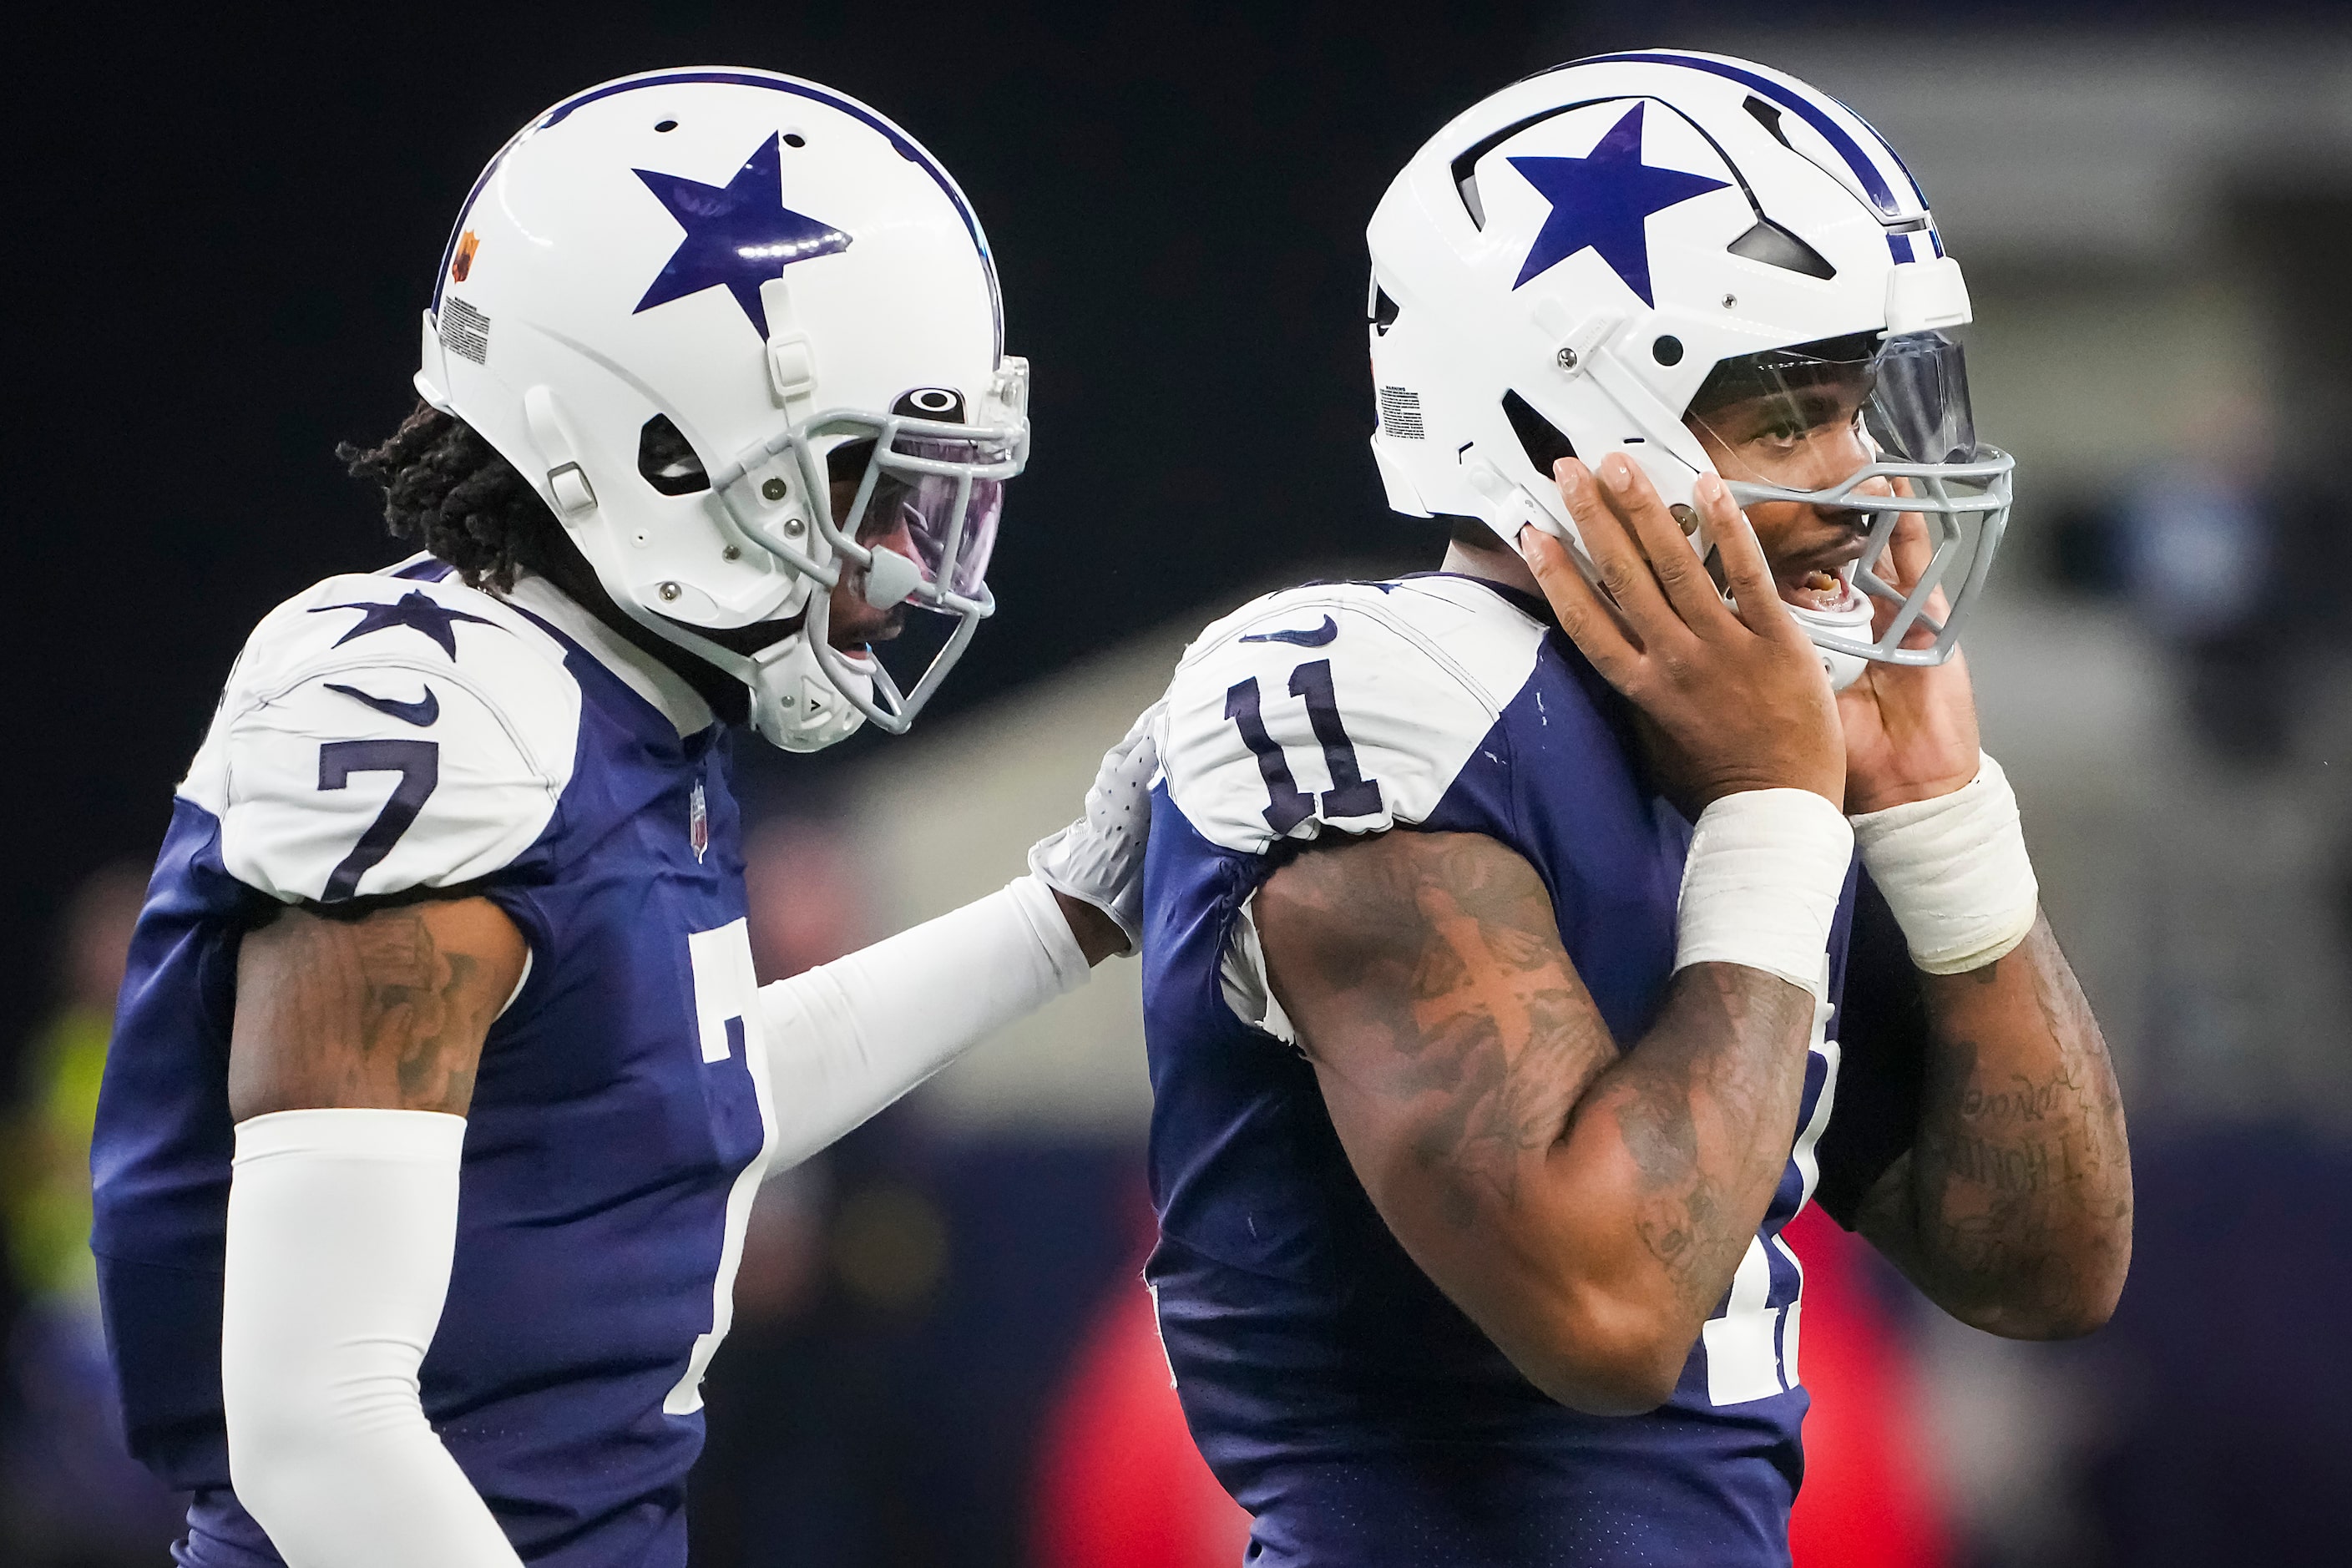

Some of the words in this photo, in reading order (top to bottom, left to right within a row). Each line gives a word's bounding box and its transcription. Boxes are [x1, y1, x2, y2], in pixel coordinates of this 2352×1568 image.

[317, 739, 439, 903] 7
[1224, 658, 1383, 836] 11
[662, 917, 779, 1414] 7
